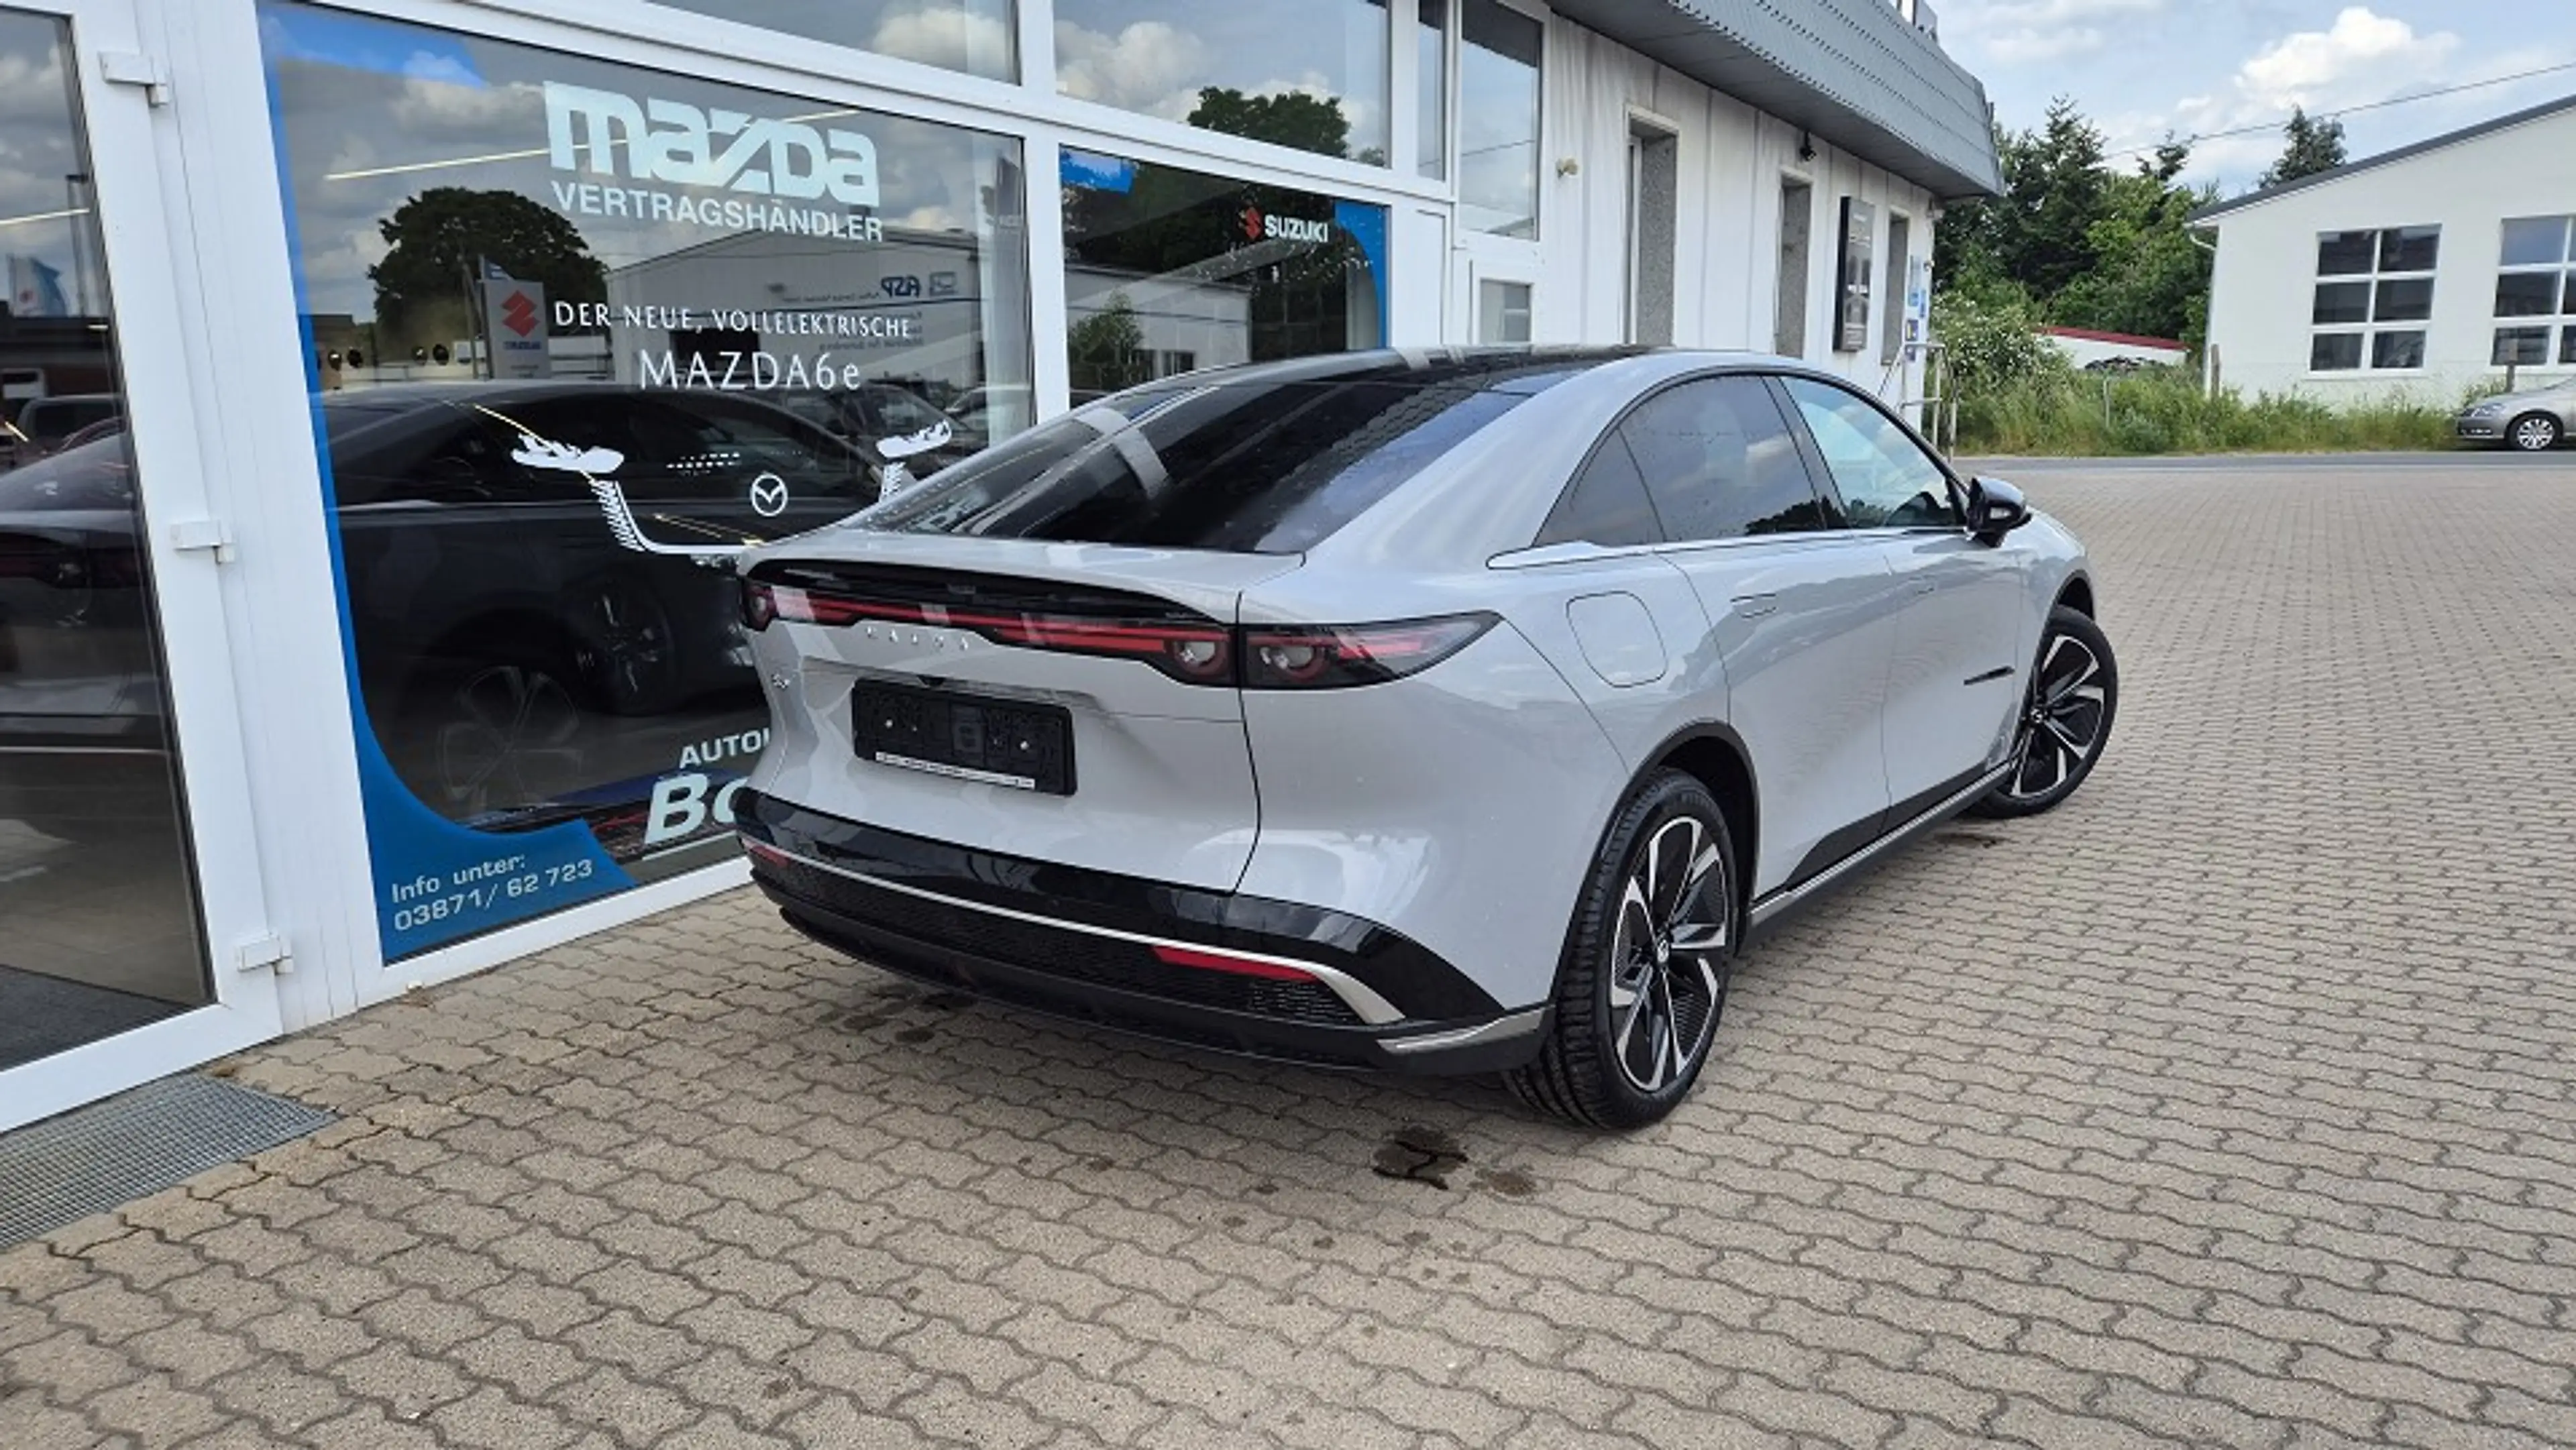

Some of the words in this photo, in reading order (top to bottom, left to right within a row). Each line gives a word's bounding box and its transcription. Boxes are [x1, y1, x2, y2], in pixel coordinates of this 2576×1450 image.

[551, 180, 883, 243] VERTRAGSHÄNDLER
[1265, 214, 1328, 243] SUZUKI
[554, 300, 612, 327] DER
[624, 305, 702, 334] NEUE,
[712, 309, 911, 338] VOLLELEKTRISCHE
[639, 349, 861, 390] MAZDA6e
[679, 727, 771, 769] AUTO
[392, 875, 441, 904] Info
[453, 854, 526, 885] unter:
[506, 874, 539, 897] 62
[545, 859, 594, 887] 723
